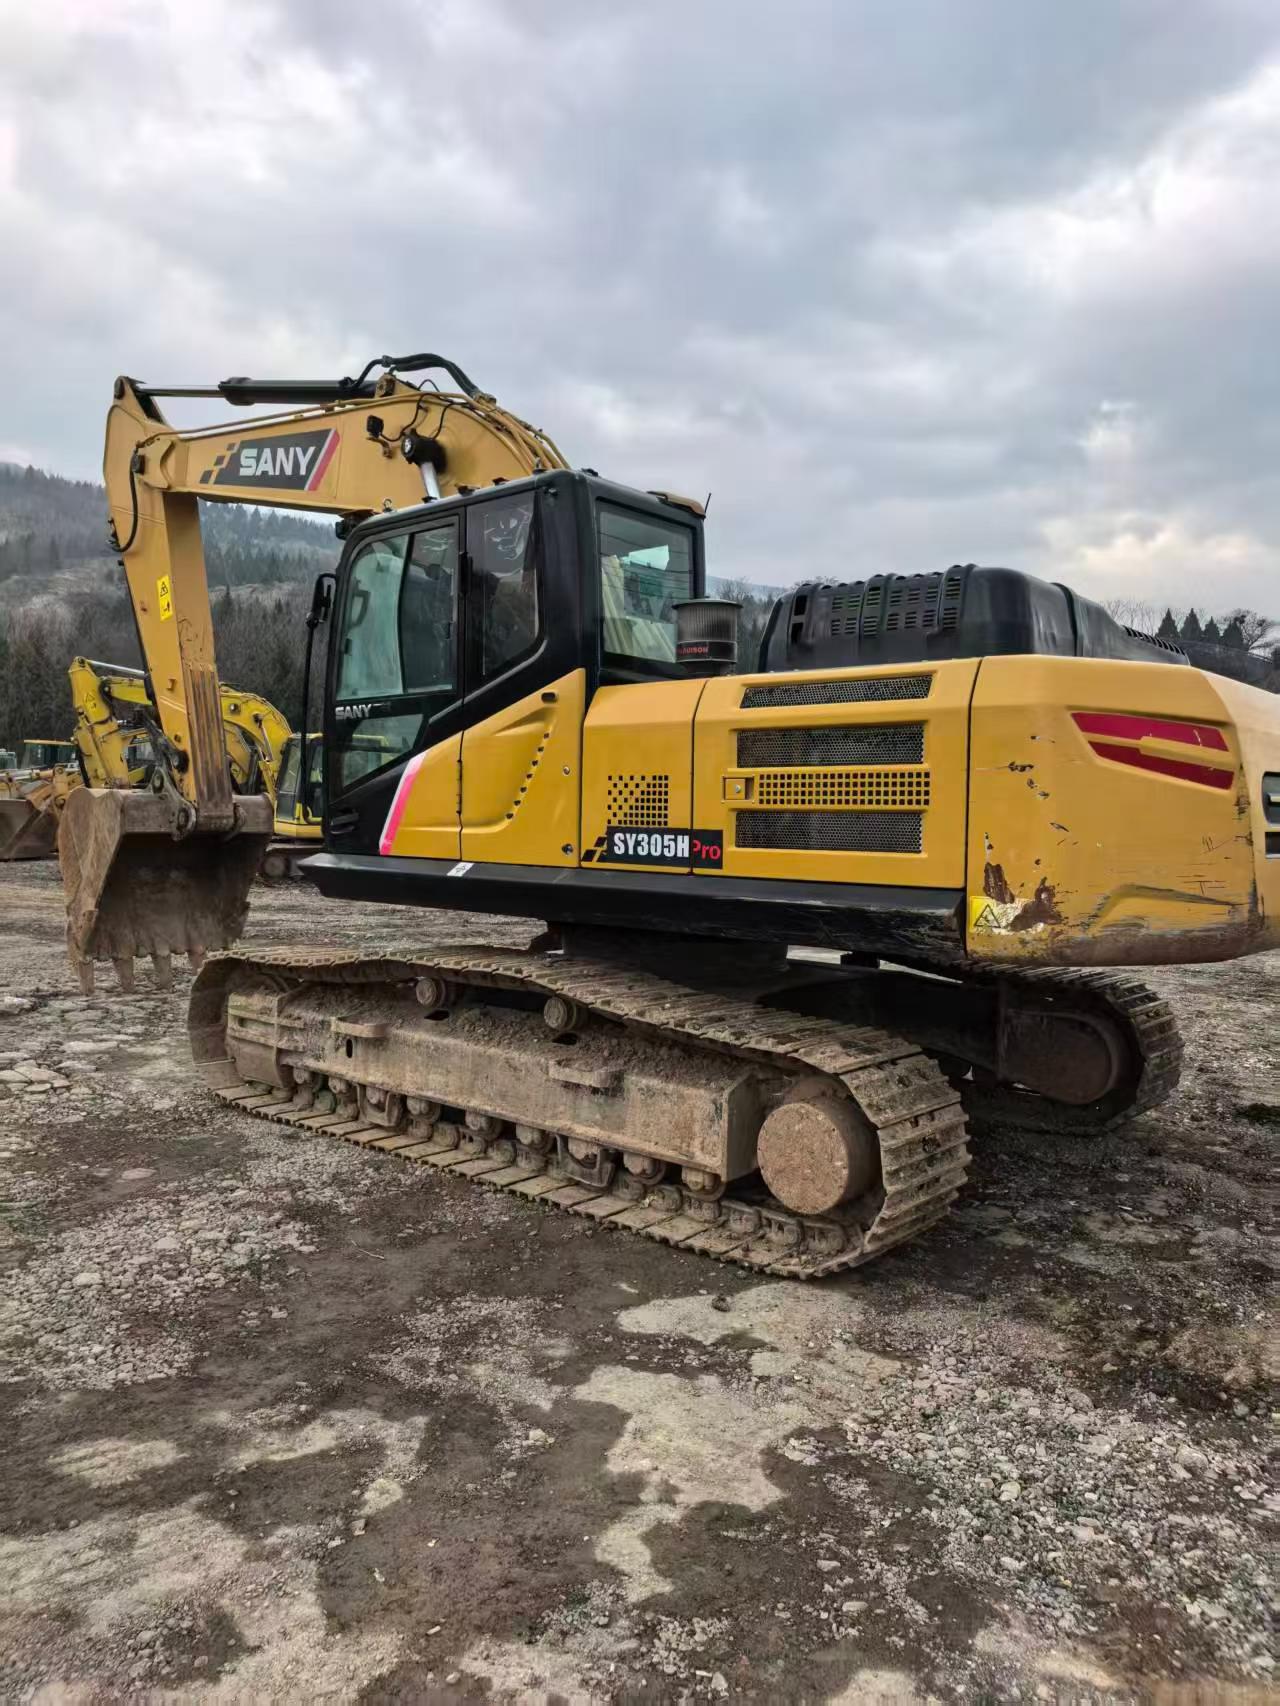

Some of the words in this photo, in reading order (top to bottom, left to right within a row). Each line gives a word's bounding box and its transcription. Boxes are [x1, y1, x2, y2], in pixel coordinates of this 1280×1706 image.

[239, 446, 316, 476] SANY
[335, 703, 372, 720] SANY
[613, 832, 690, 858] SY305H
[692, 839, 721, 860] Pro
